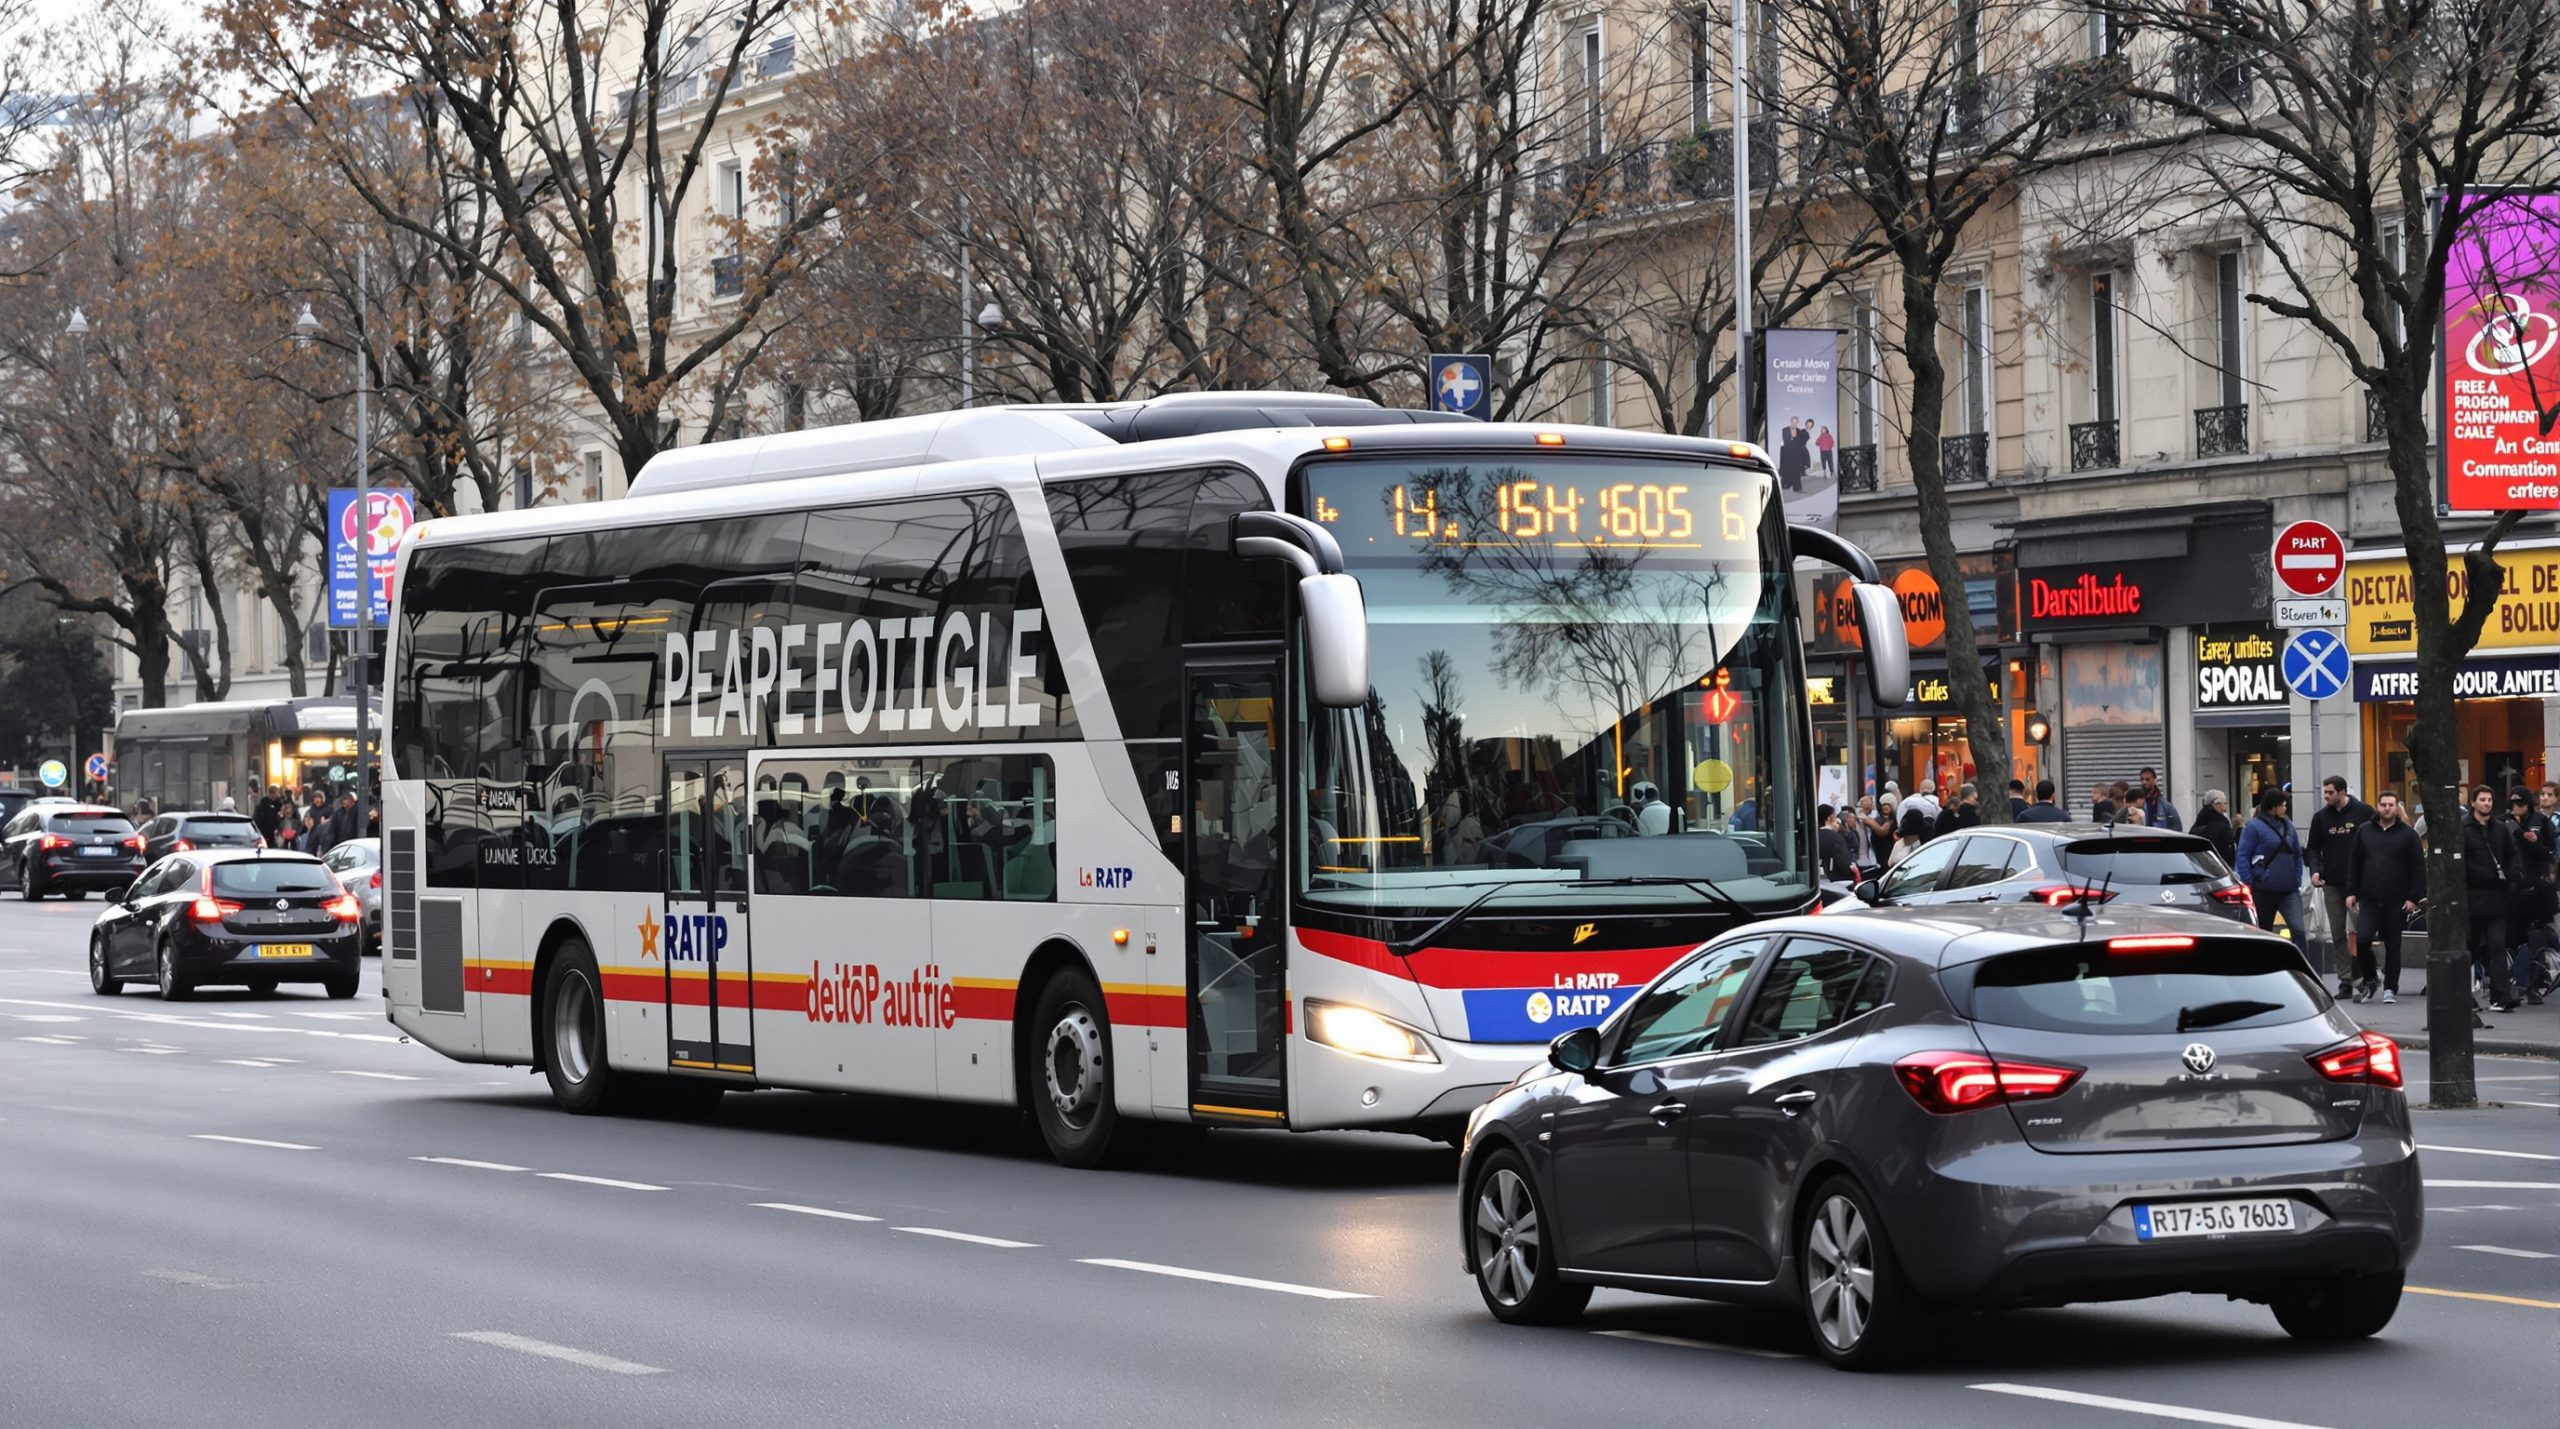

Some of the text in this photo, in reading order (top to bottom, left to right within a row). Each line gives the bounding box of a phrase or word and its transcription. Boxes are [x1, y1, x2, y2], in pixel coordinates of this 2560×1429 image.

[2455, 380, 2498, 394] FREE A
[2199, 665, 2283, 703] SPORAL
[1096, 867, 1133, 889] RATP
[1554, 973, 1620, 990] La RATP
[1556, 995, 1611, 1017] RATP
[2239, 1203, 2289, 1229] 7603
